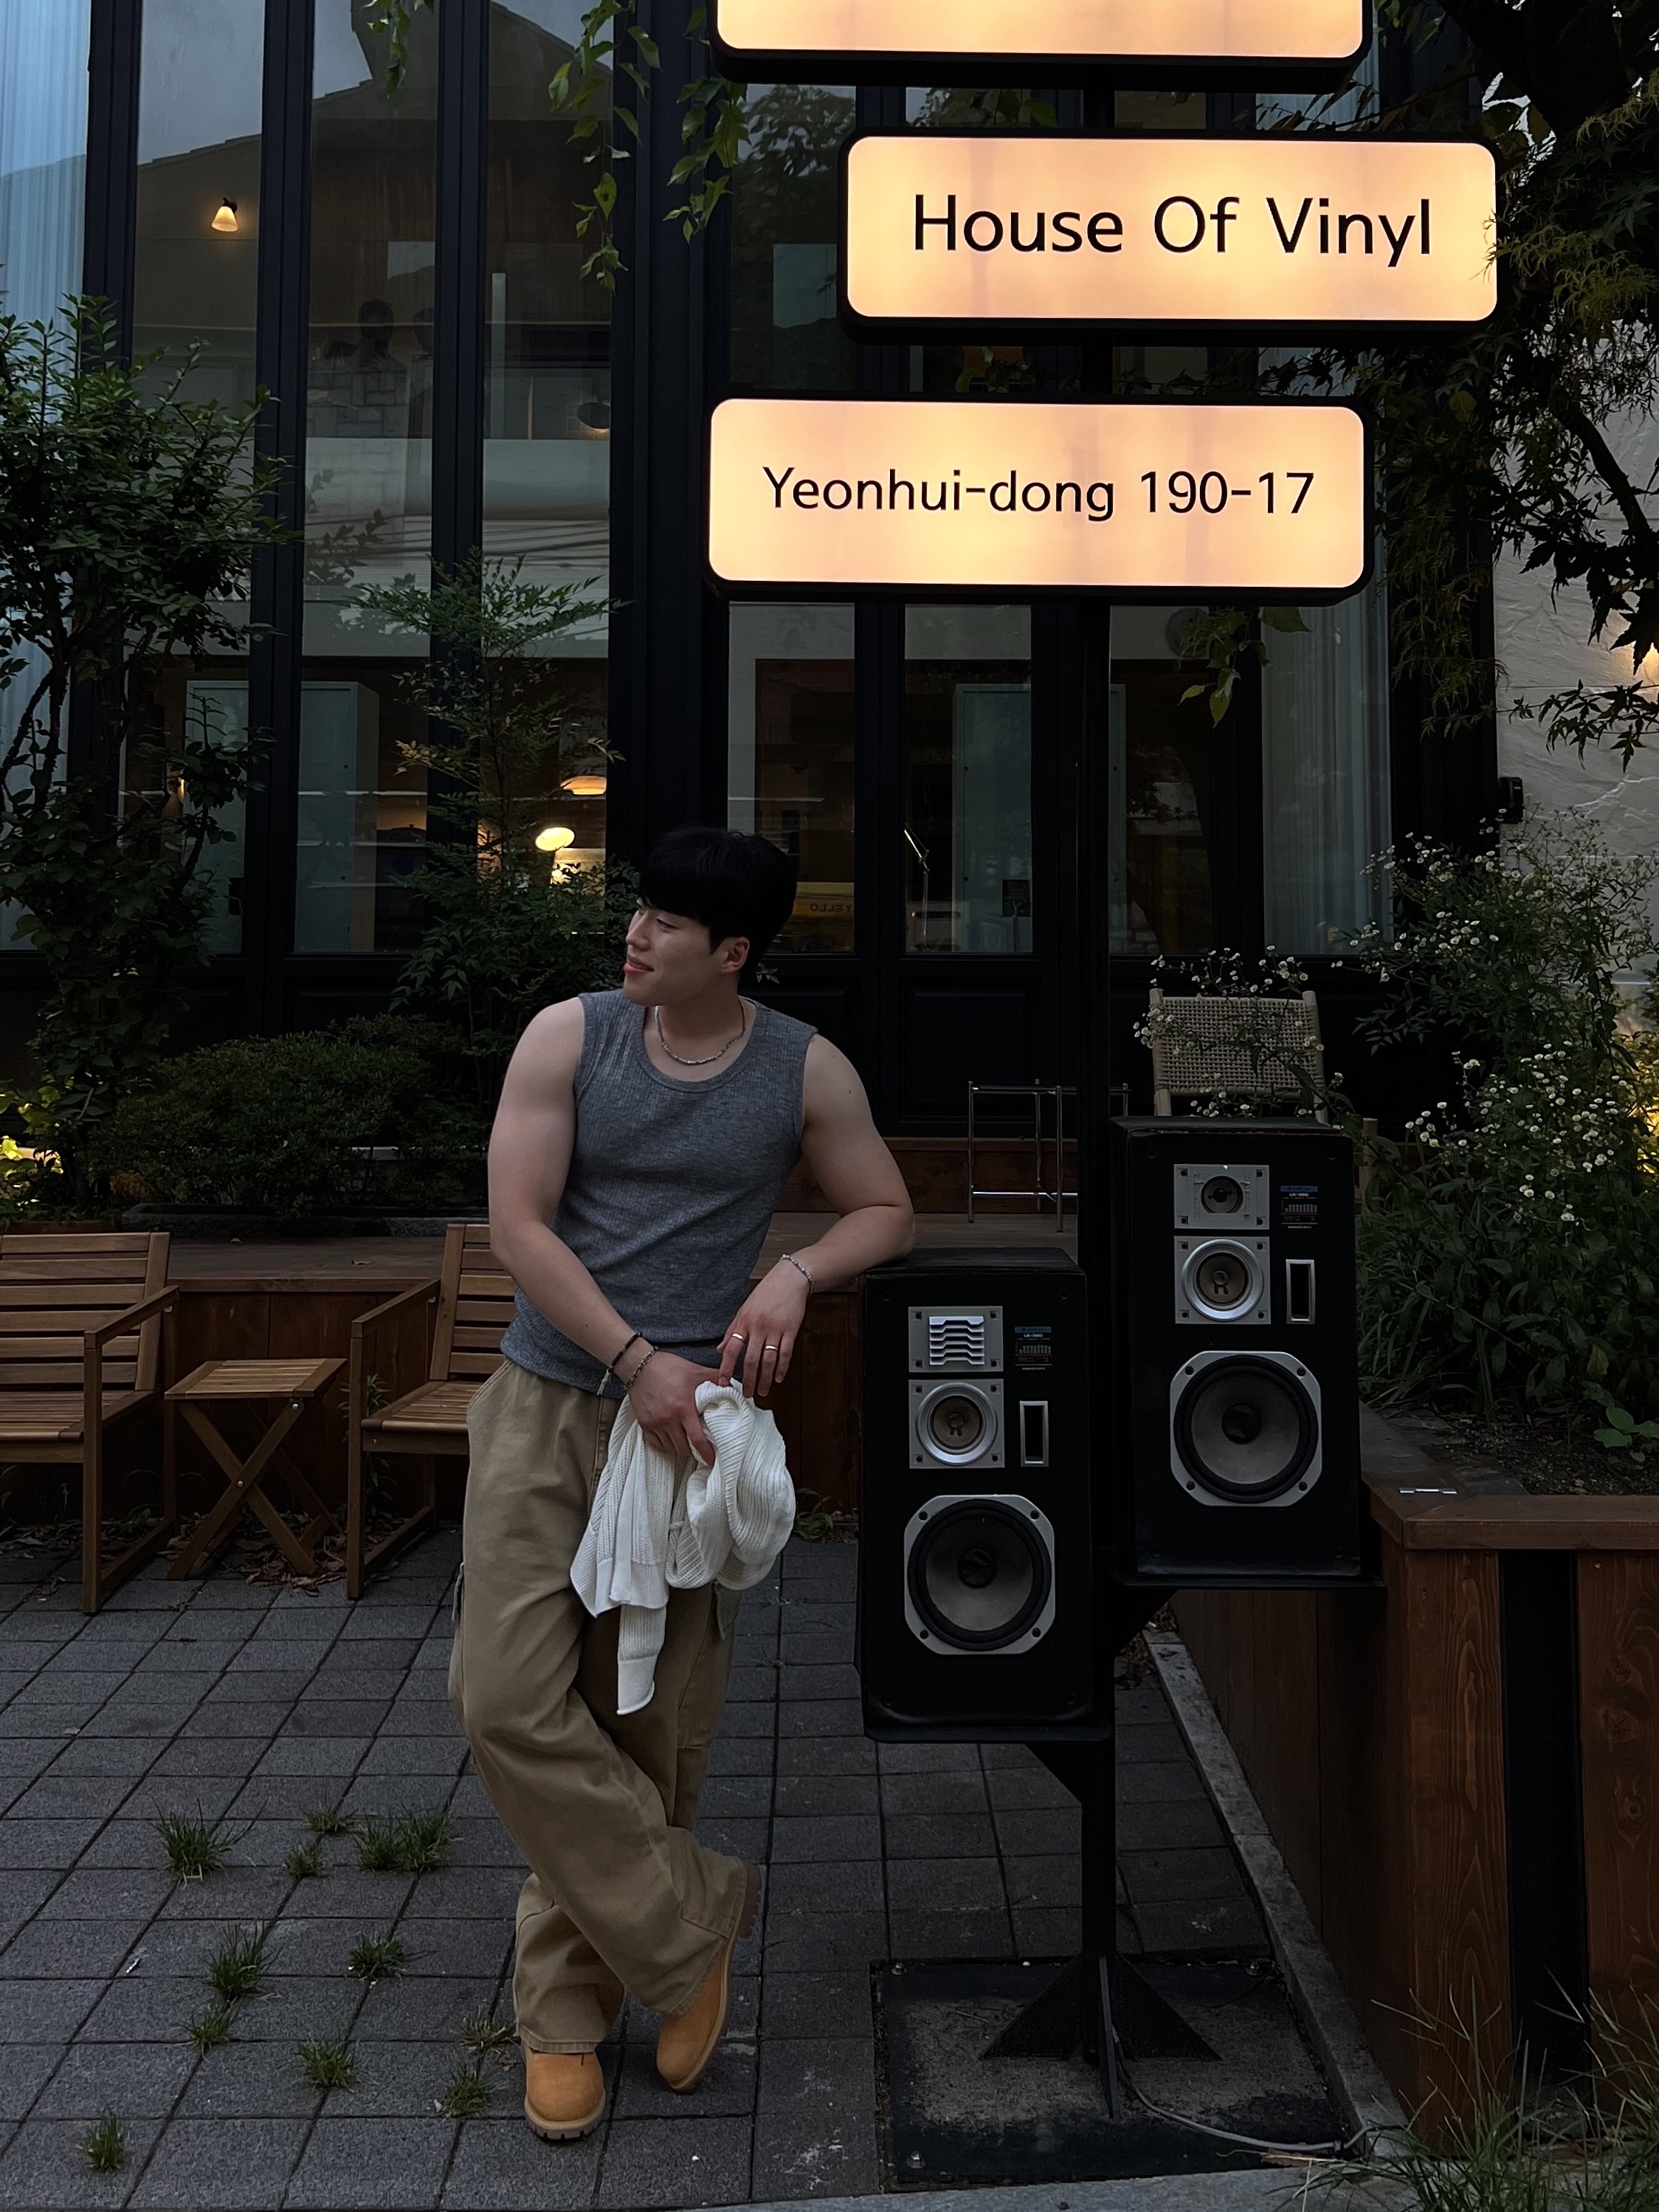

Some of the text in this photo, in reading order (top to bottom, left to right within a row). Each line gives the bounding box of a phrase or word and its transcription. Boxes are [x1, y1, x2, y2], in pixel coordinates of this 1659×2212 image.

[915, 194, 1430, 268] House Of Vinyl
[762, 466, 1314, 522] Yeonhui-dong 190-17
